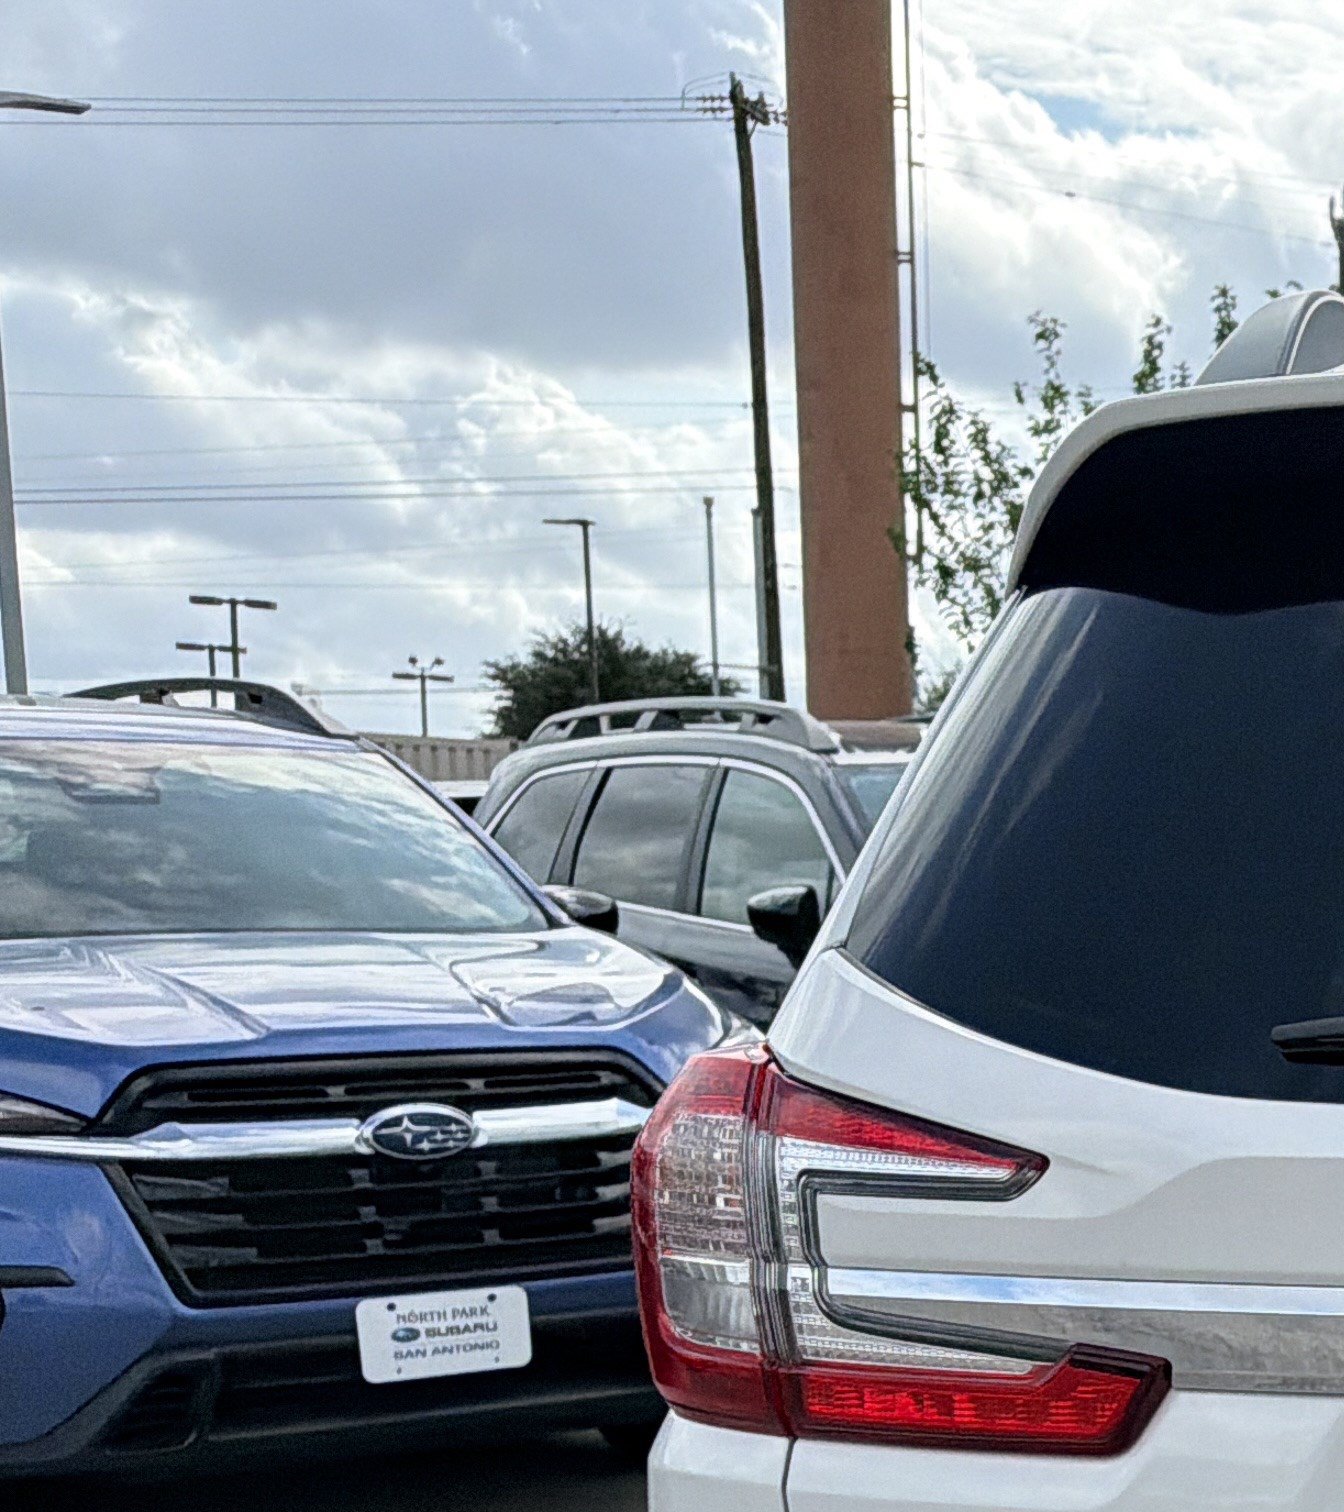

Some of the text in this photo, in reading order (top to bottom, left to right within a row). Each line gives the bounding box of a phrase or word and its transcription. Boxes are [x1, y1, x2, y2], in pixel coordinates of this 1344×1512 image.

[396, 1304, 491, 1324] NORTH PARK
[424, 1321, 498, 1338] SUBARU
[393, 1339, 500, 1361] SAN ANTONIO
